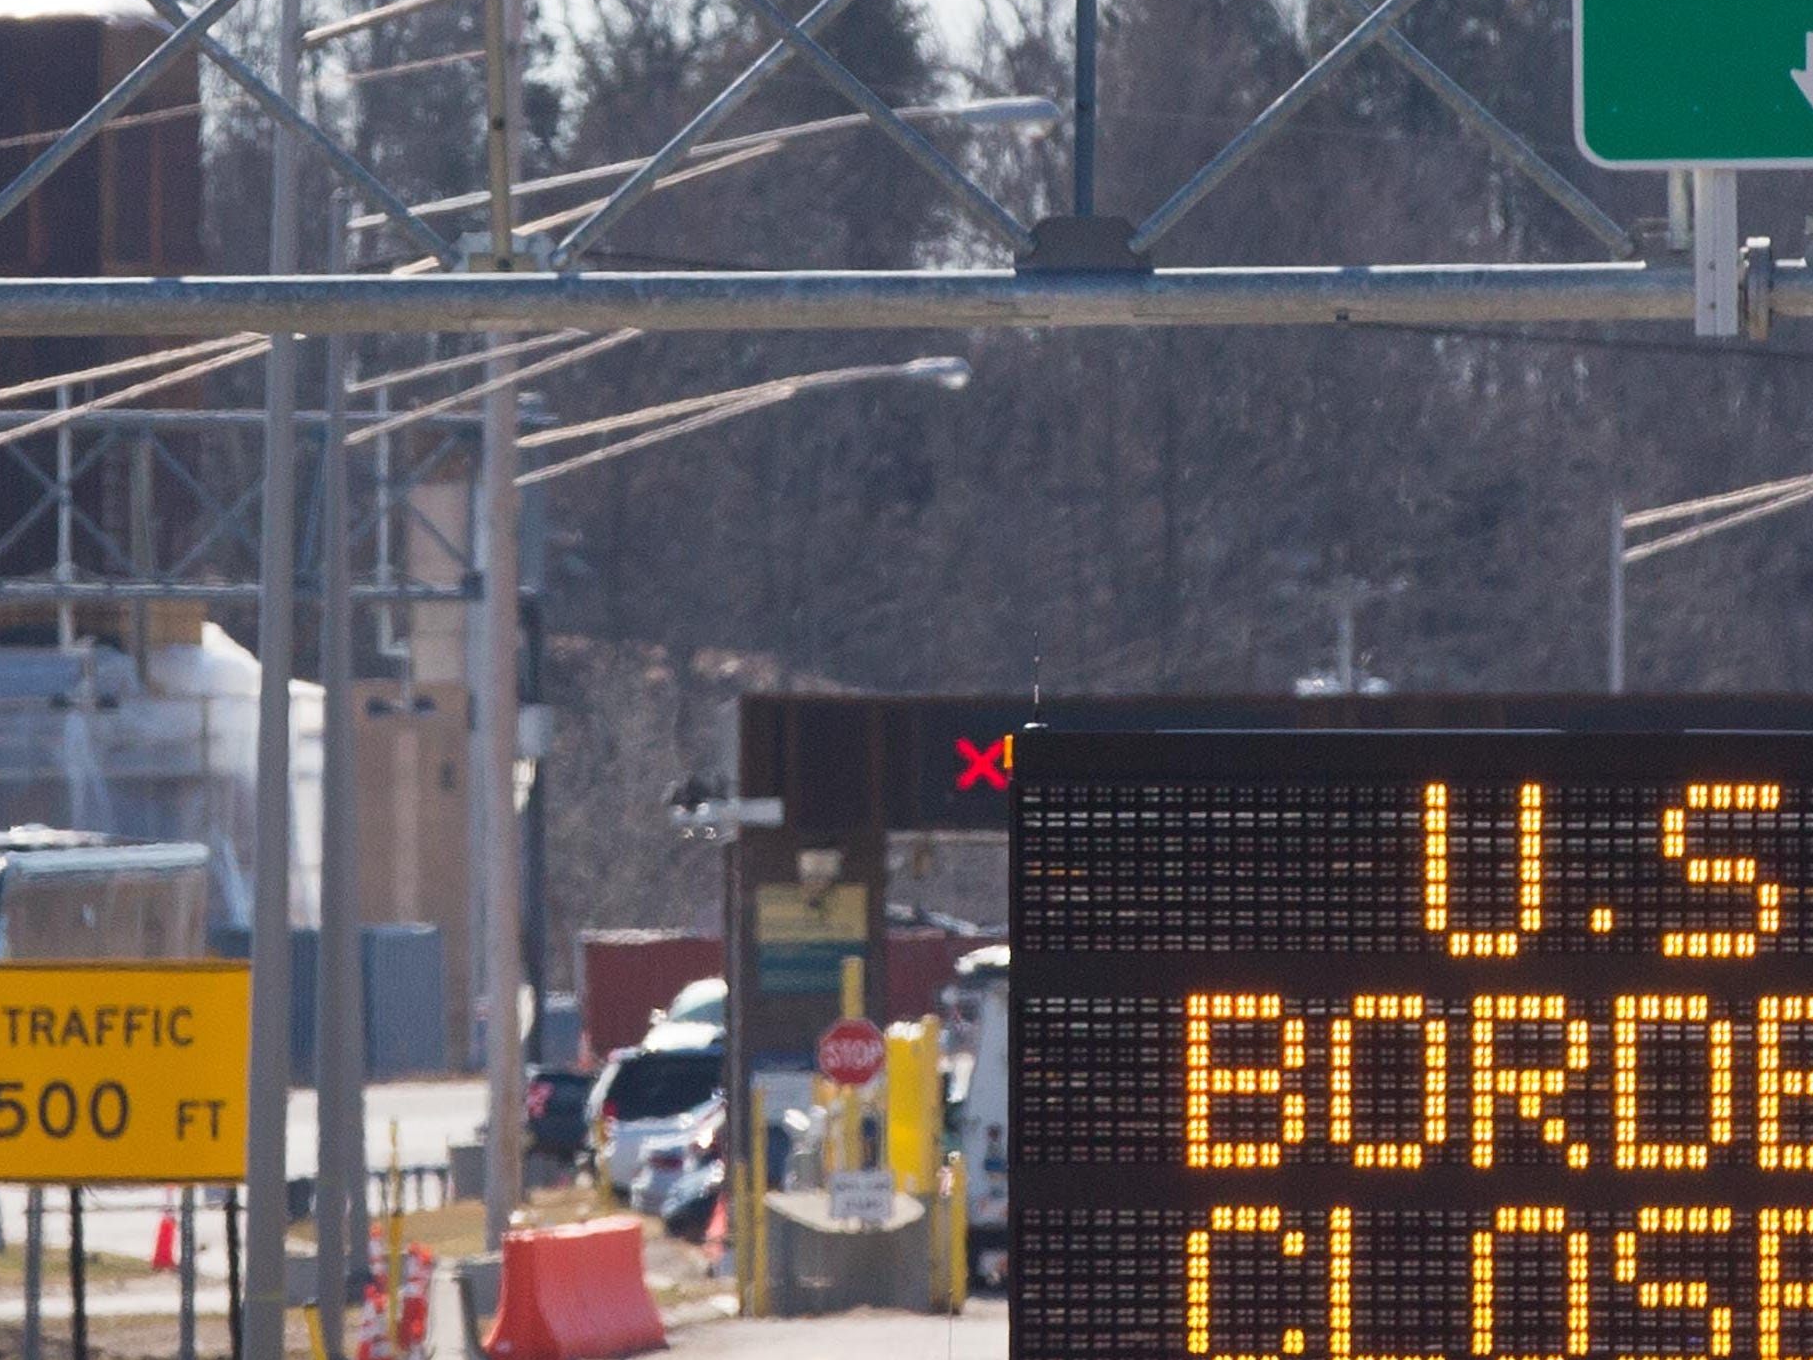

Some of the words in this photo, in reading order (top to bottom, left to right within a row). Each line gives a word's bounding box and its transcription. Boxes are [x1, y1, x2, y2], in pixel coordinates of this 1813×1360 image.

[1424, 783, 1780, 958] U.S
[4, 1006, 195, 1047] TRAFFIC
[826, 1038, 883, 1069] STOP
[176, 1099, 227, 1141] FT
